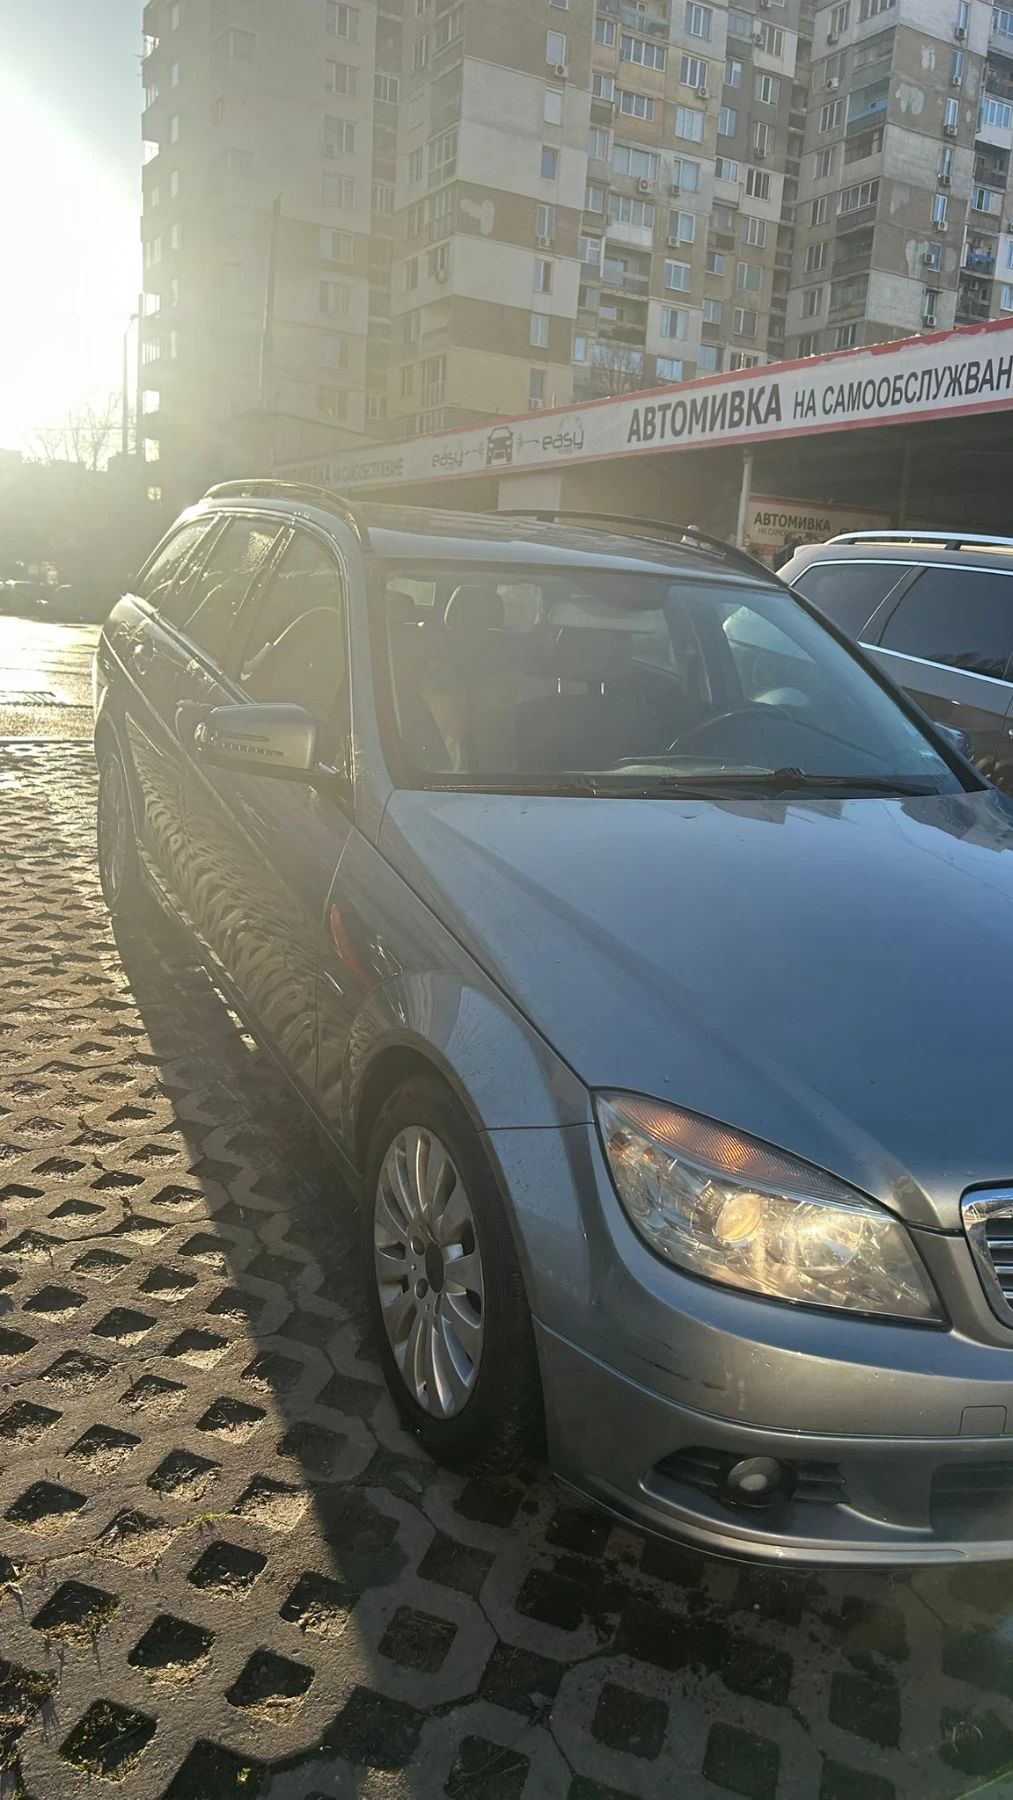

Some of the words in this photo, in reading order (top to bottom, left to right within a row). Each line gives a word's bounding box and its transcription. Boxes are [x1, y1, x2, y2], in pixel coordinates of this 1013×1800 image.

[627, 383, 782, 444] АВТОМИВКА
[793, 390, 816, 420] НА
[822, 355, 1013, 416] САМООБСЛУЖВАН
[542, 430, 584, 451] easy
[432, 449, 463, 468] easy
[753, 511, 831, 532] АВТОМИВКА
